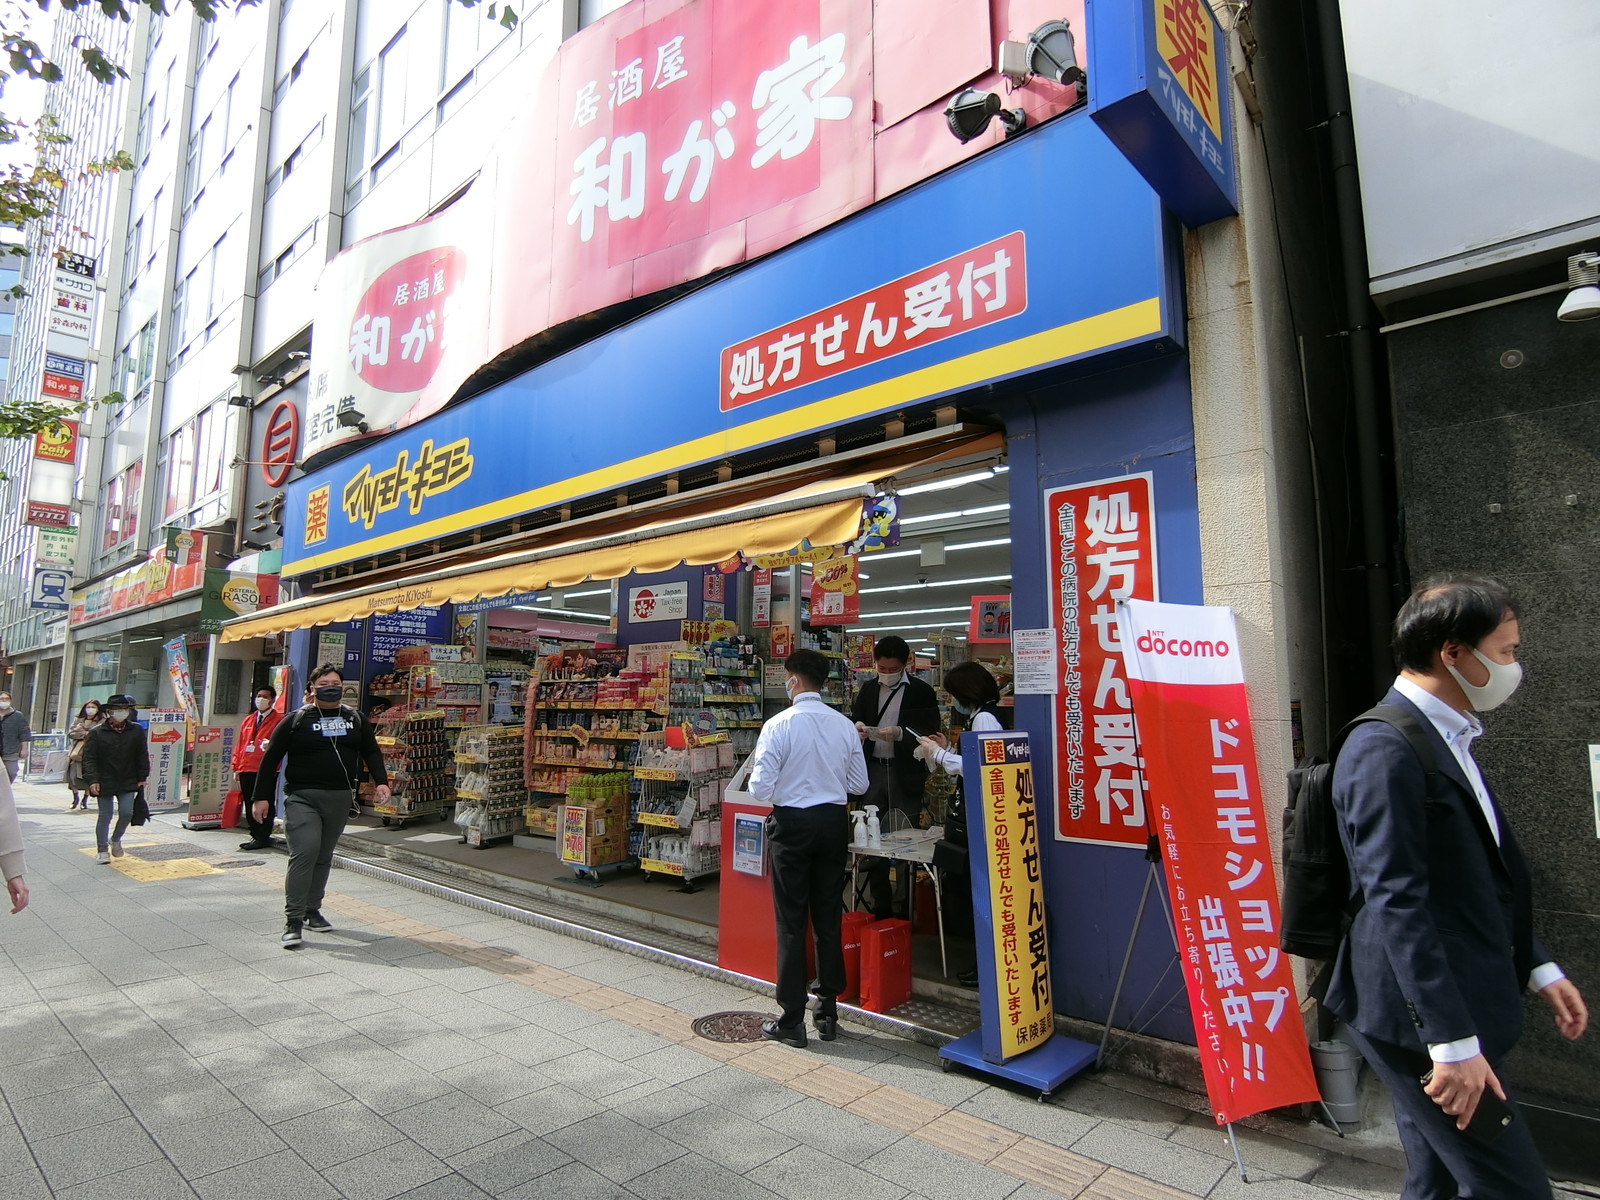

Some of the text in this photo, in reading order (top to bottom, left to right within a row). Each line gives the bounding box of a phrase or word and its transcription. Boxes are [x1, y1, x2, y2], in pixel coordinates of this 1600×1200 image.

[570, 35, 689, 131] 居酒屋
[566, 32, 854, 243] 和が家
[1157, 66, 1225, 175] マツモトキヨシ
[392, 269, 446, 306] 居酒屋
[350, 309, 452, 374] 和が
[728, 248, 1011, 400] 処方せん受付
[343, 440, 473, 526] マツモトキヨシ
[307, 490, 329, 543] 薬
[208, 591, 273, 605] GIRASOLE
[662, 588, 682, 597] Japan
[668, 606, 683, 614] Shop
[350, 621, 362, 629] 1F
[1136, 629, 1230, 657] docomo
[347, 653, 359, 661] B1
[1057, 503, 1085, 819] 全国どこの病院の処方せんでも受付いたします
[164, 713, 186, 722] 歯科
[311, 721, 354, 731] DESIGN
[985, 741, 1004, 762] 薬
[988, 767, 1022, 1026] 全国どこの処方せんでも受付いたします
[1014, 768, 1051, 1012] 処方せん受付
[1209, 718, 1290, 1033] ドコモショップ
